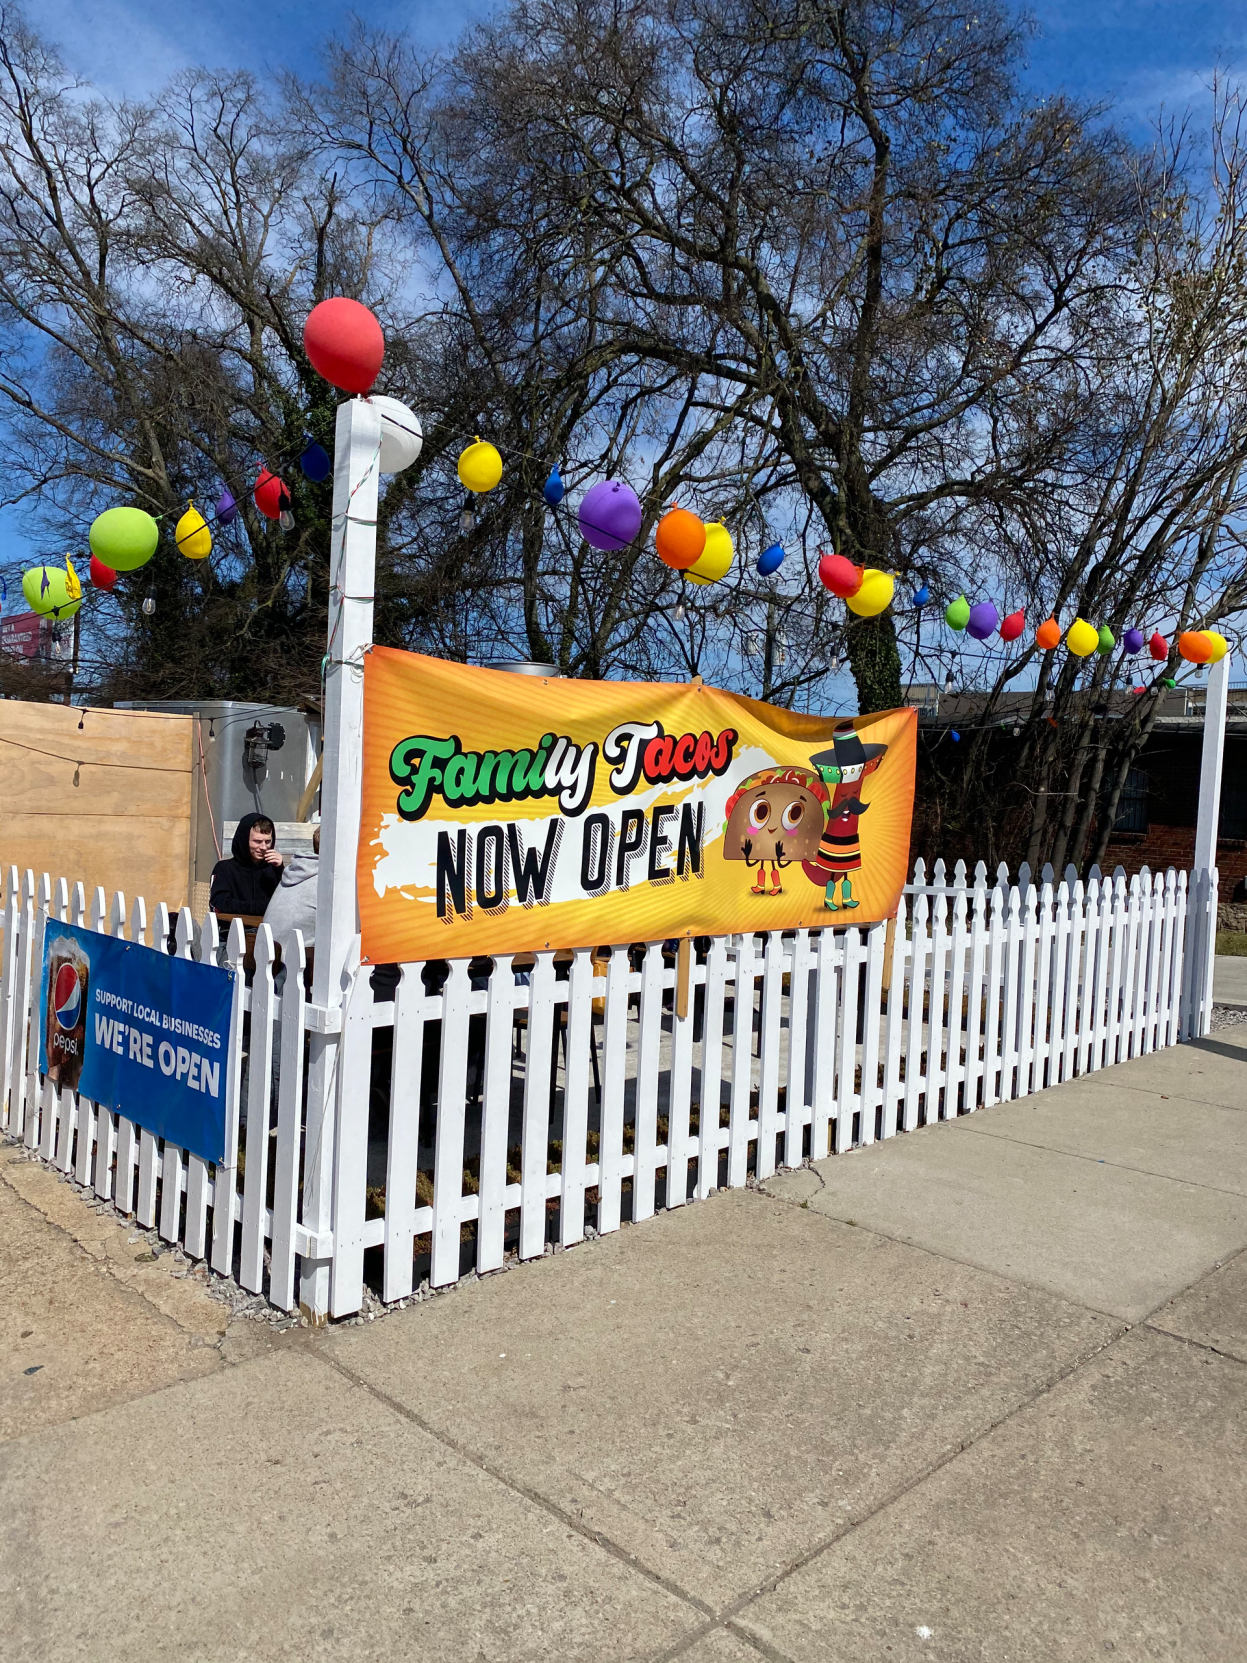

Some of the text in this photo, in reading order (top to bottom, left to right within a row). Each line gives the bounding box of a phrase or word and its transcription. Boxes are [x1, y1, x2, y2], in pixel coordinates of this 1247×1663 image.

[389, 720, 738, 821] Family Tacos
[436, 801, 706, 922] NOW OPEN
[53, 1032, 78, 1056] pepsi
[94, 1012, 220, 1098] WE'RE OPEN
[95, 988, 221, 1049] SUPPORT LOCAL BUSINESSES
